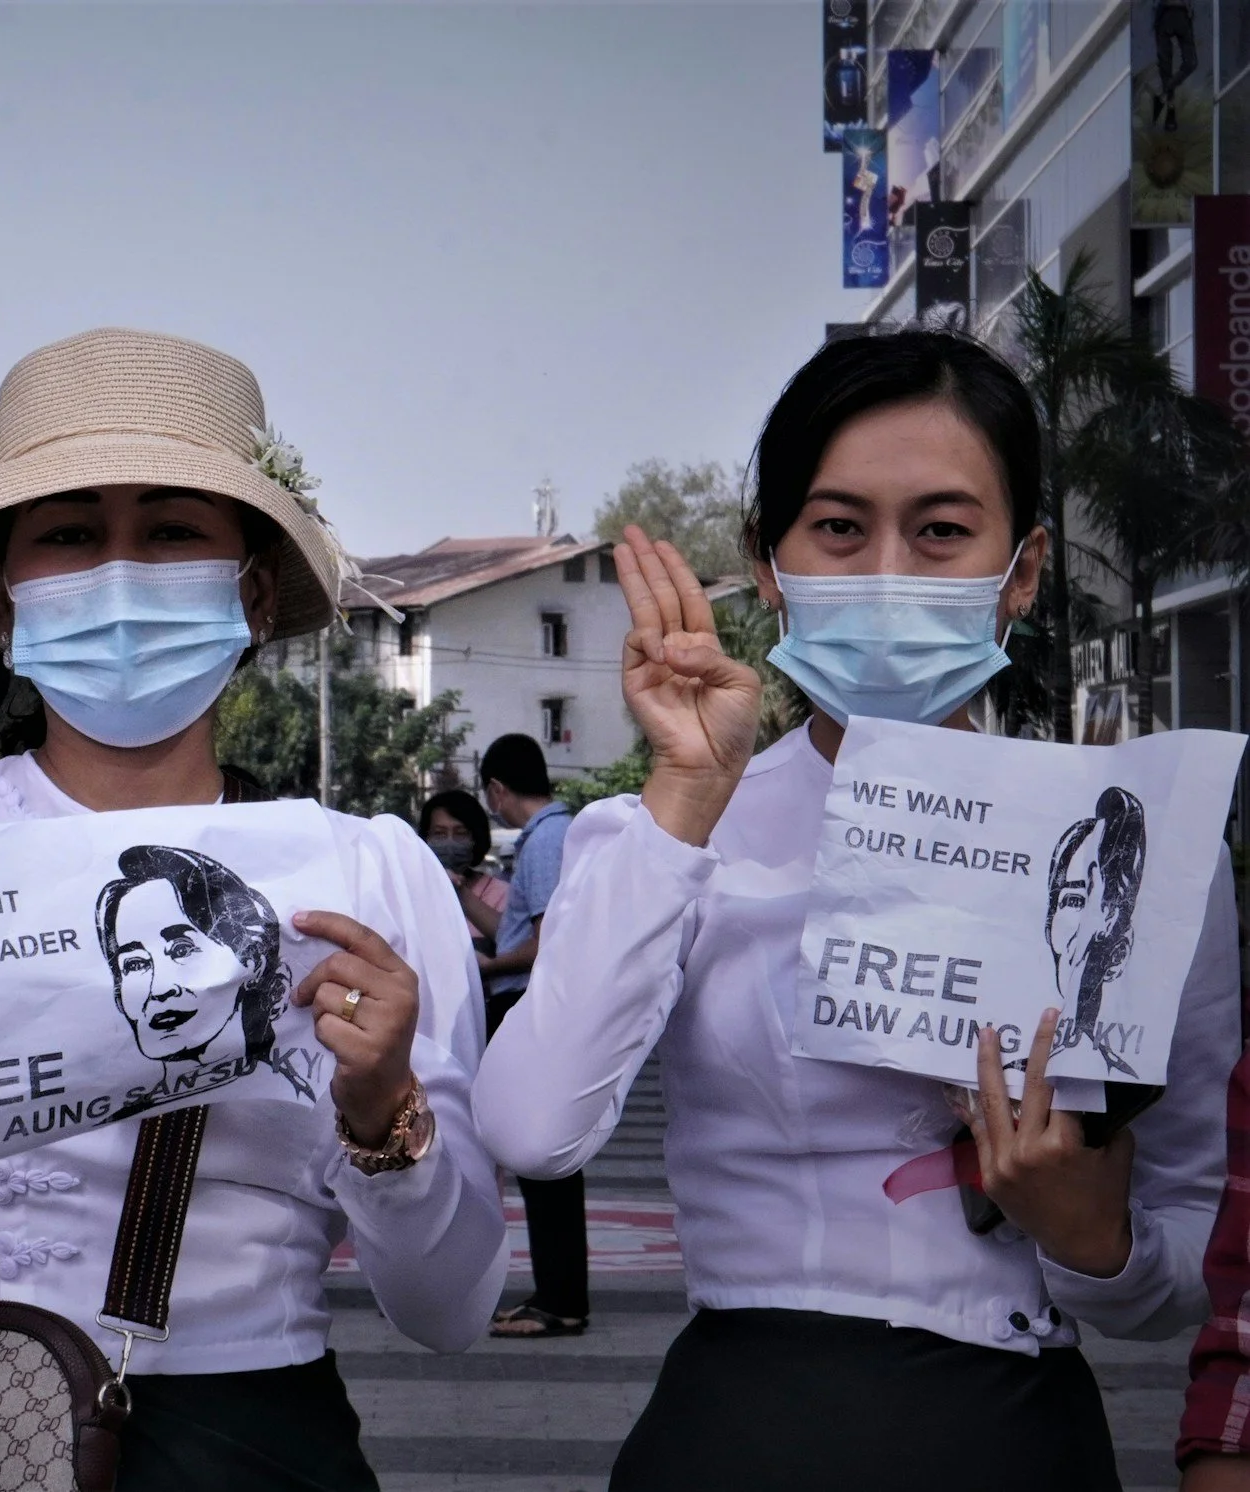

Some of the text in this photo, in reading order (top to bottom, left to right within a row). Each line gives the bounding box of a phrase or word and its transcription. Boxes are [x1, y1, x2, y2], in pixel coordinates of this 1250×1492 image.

[1218, 244, 1250, 438] oodpanda
[853, 780, 993, 824] WE WANT
[845, 826, 1031, 876] OUR LEADER
[817, 937, 983, 1004] FREE
[813, 994, 902, 1035] DAW
[907, 1011, 1022, 1054] AUNG
[3, 1095, 111, 1142] AUNG
[123, 1071, 198, 1108] SAN
